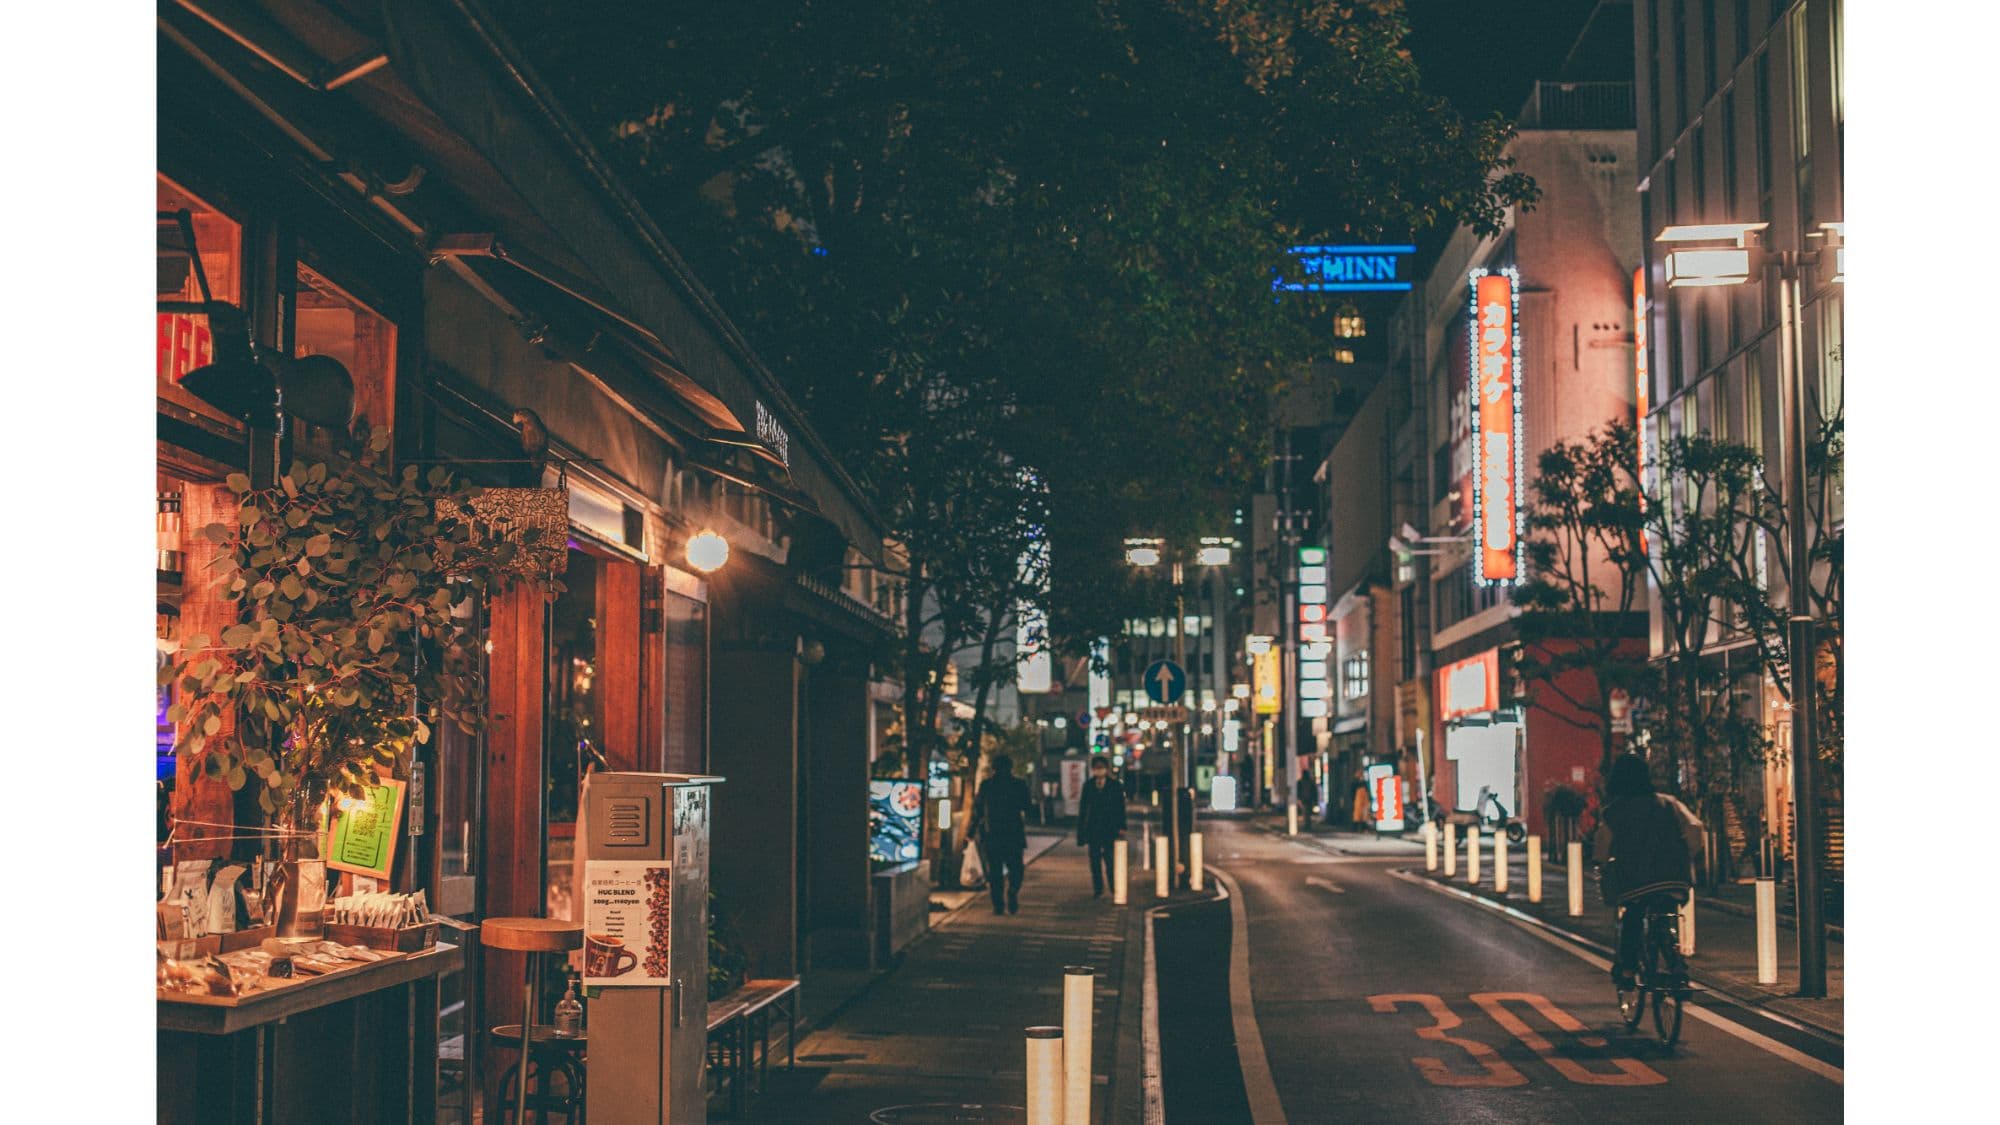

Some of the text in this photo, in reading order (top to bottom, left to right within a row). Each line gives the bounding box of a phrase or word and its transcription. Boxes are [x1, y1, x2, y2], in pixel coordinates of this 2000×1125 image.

[1483, 302, 1509, 404] カラオケ
[1367, 992, 1668, 1086] 30
